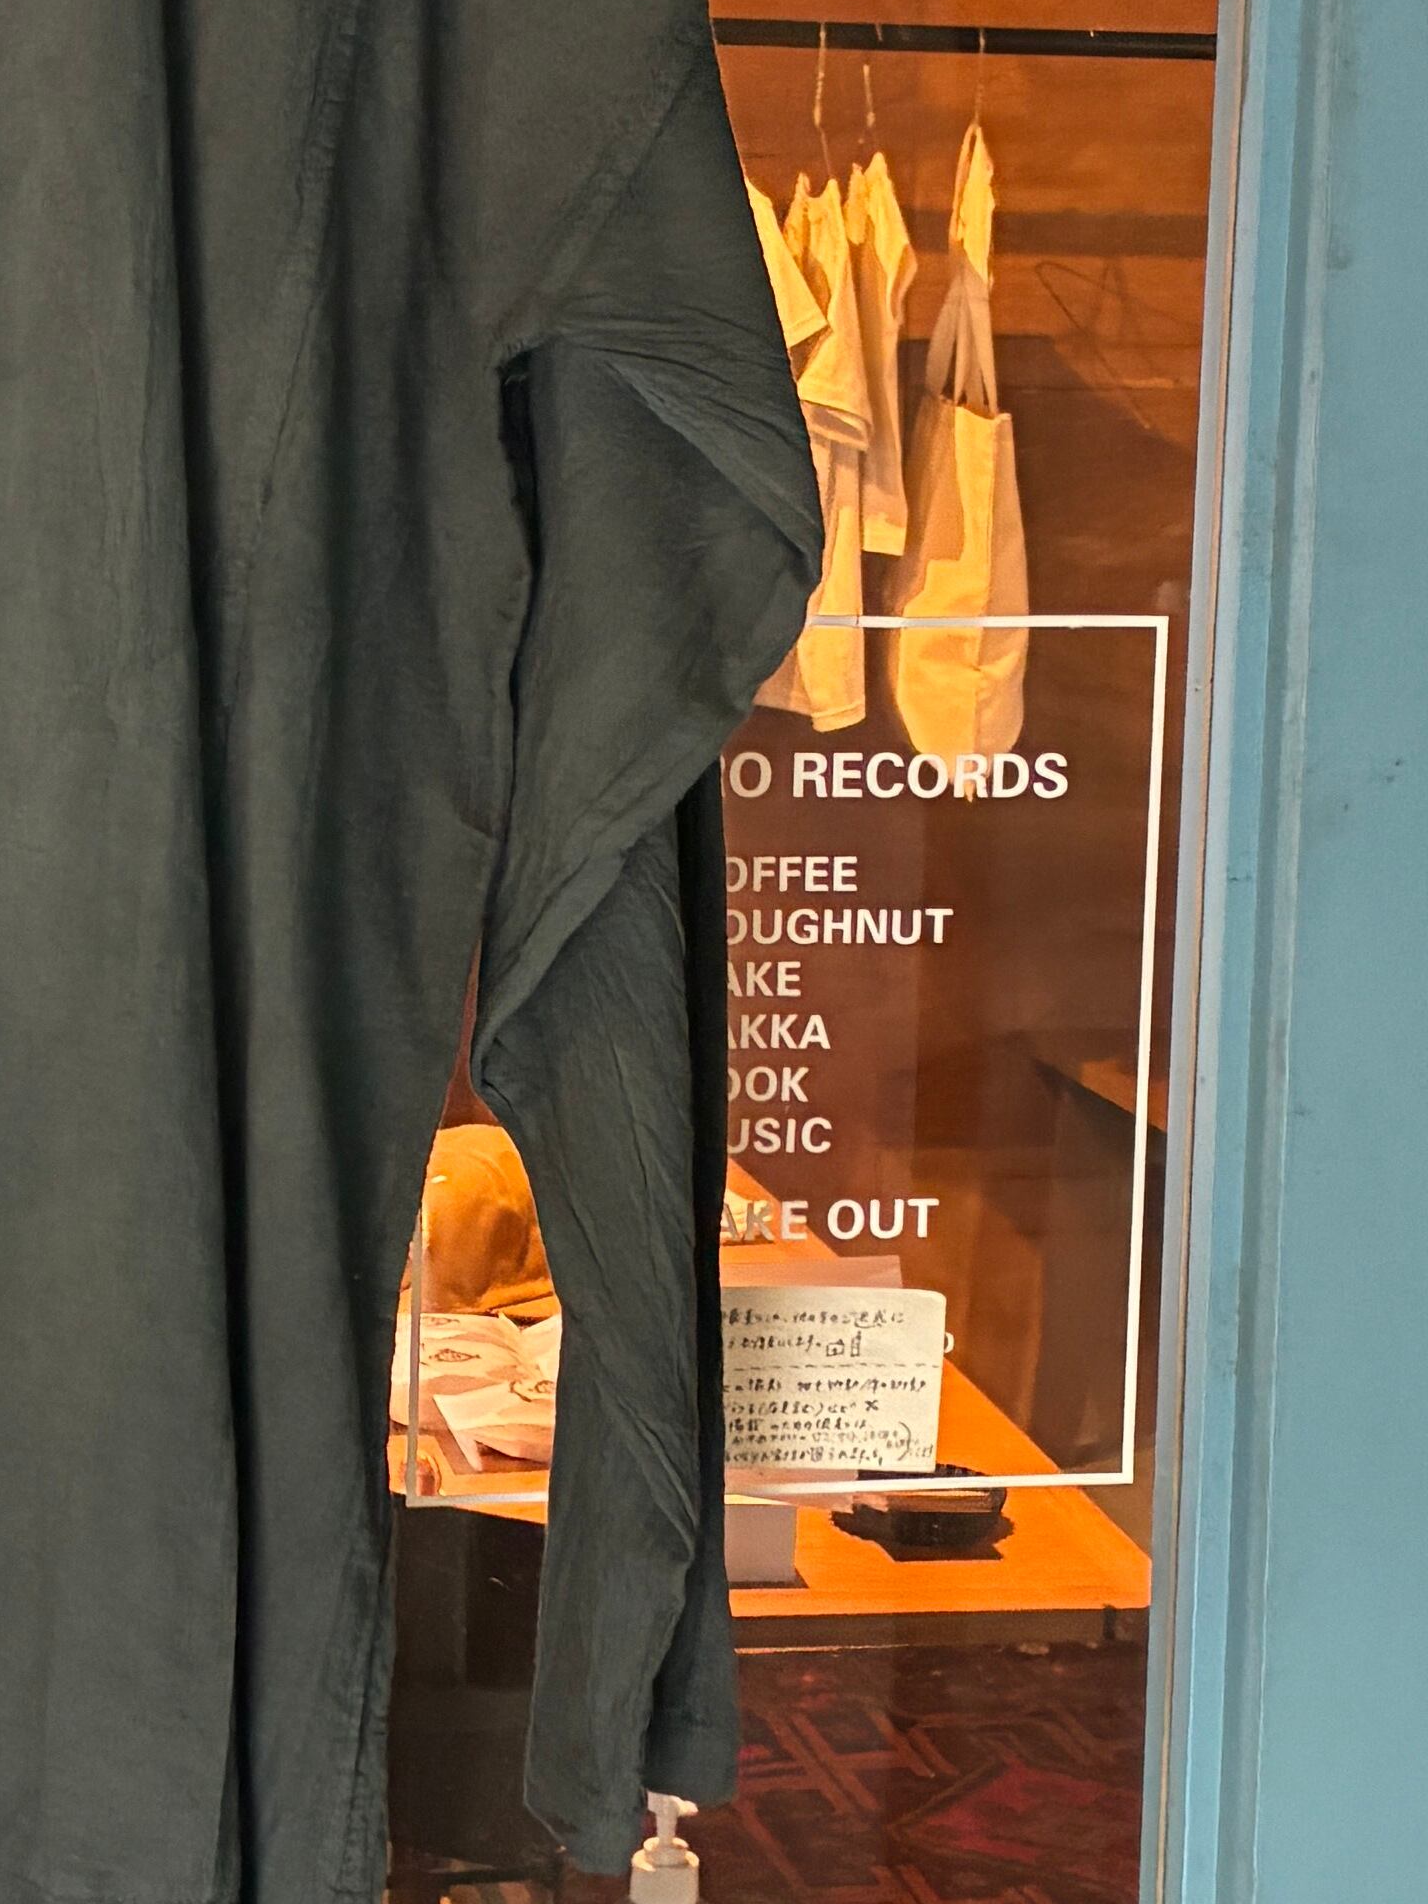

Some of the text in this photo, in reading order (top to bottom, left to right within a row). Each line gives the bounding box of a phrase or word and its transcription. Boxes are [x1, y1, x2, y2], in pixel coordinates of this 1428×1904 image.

[720, 752, 1069, 799] O RECORDS
[827, 1198, 940, 1240] OUT
